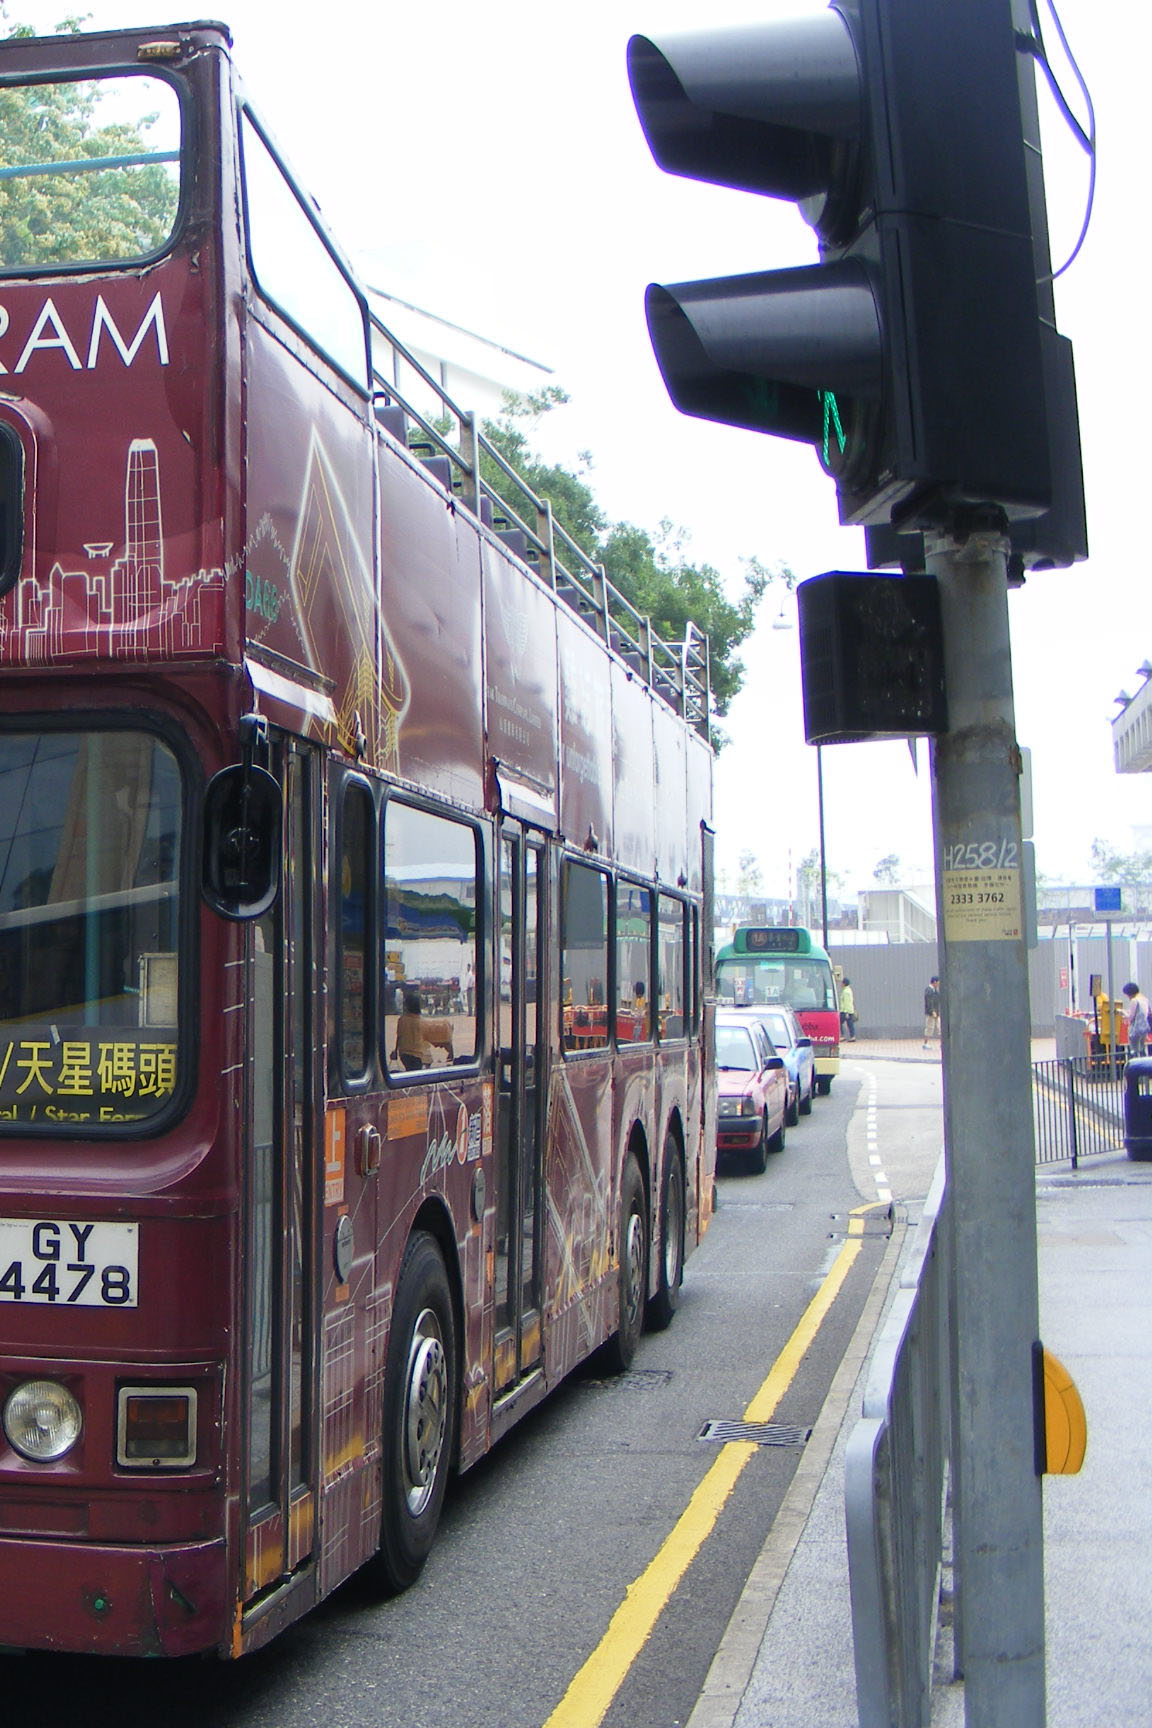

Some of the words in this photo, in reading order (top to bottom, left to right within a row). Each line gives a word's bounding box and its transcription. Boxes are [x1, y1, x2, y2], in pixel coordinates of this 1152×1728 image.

[943, 839, 1018, 870] H258/2
[951, 893, 974, 905] 2333
[977, 893, 1004, 904] 3762
[45, 1106, 90, 1122] Star
[32, 1222, 95, 1262] GY
